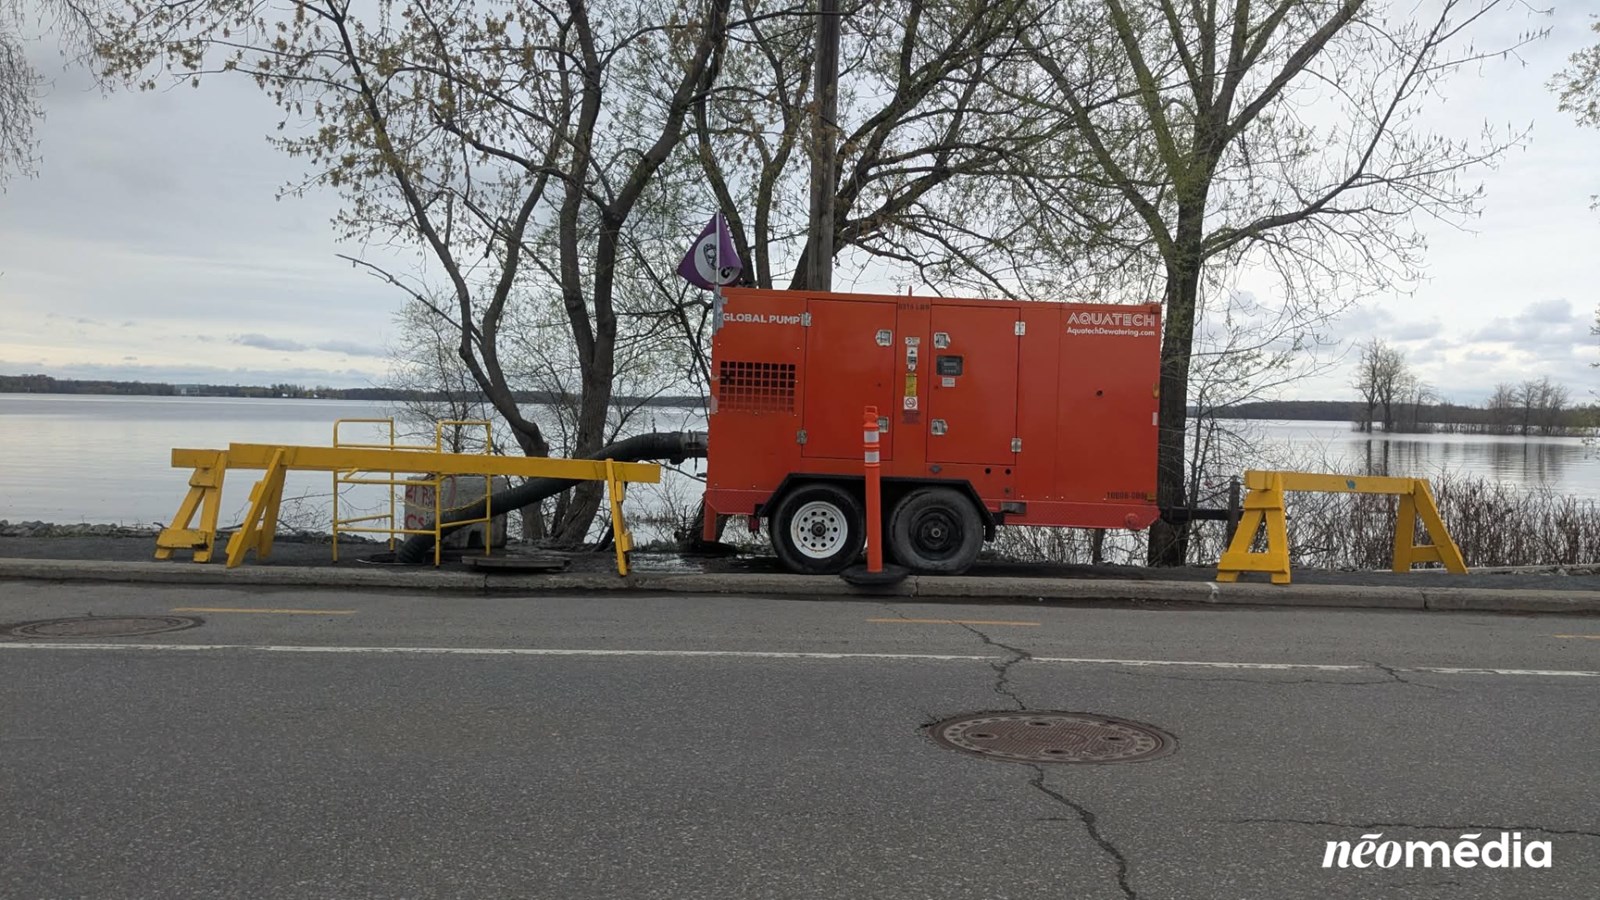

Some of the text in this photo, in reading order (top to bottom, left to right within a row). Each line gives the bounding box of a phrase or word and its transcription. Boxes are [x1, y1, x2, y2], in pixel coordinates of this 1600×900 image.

[722, 312, 800, 325] GLOBAL PUMP
[1067, 312, 1155, 327] AQUATECH
[1067, 326, 1155, 338] AquatechDewatering.com
